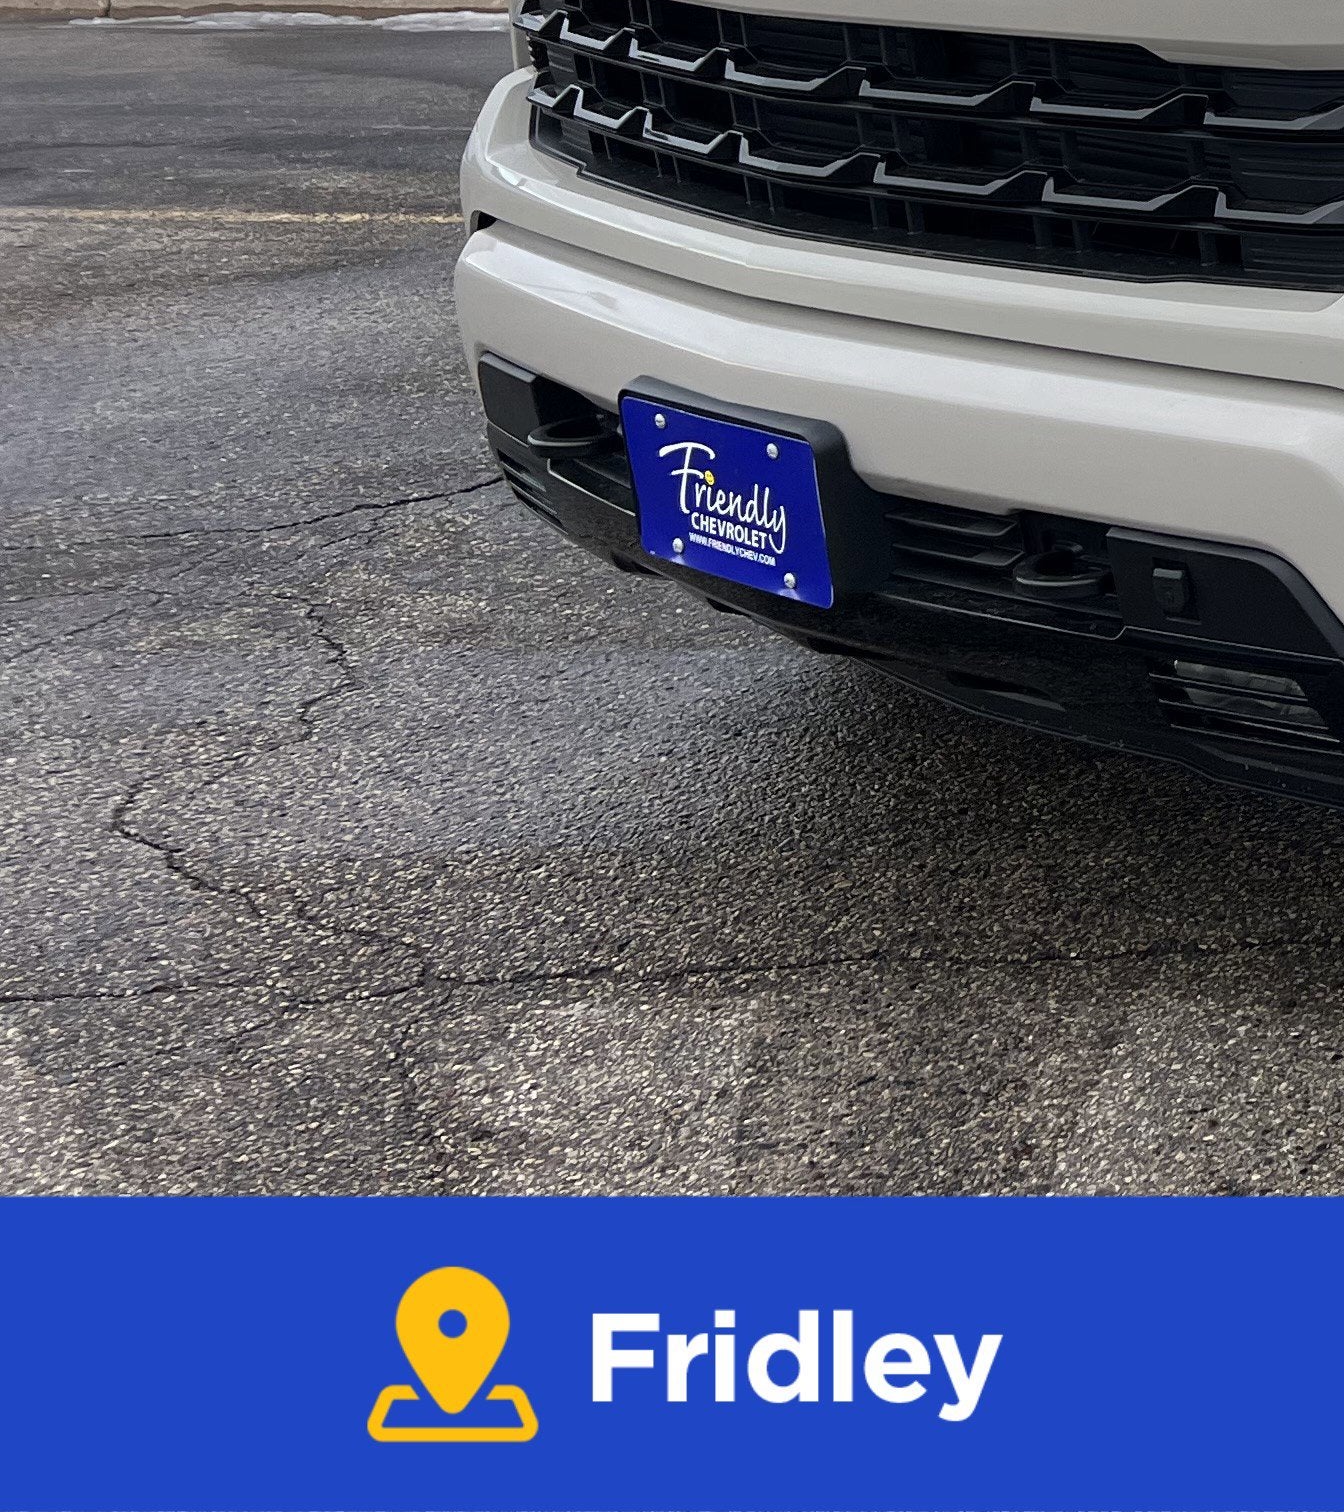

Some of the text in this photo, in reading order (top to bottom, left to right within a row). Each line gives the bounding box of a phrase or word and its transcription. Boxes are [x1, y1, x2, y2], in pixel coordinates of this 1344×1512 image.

[658, 441, 787, 555] Friendly
[688, 531, 777, 567] WWW.FRIENDLYCHEV.COM
[690, 511, 768, 550] CHEVROLET
